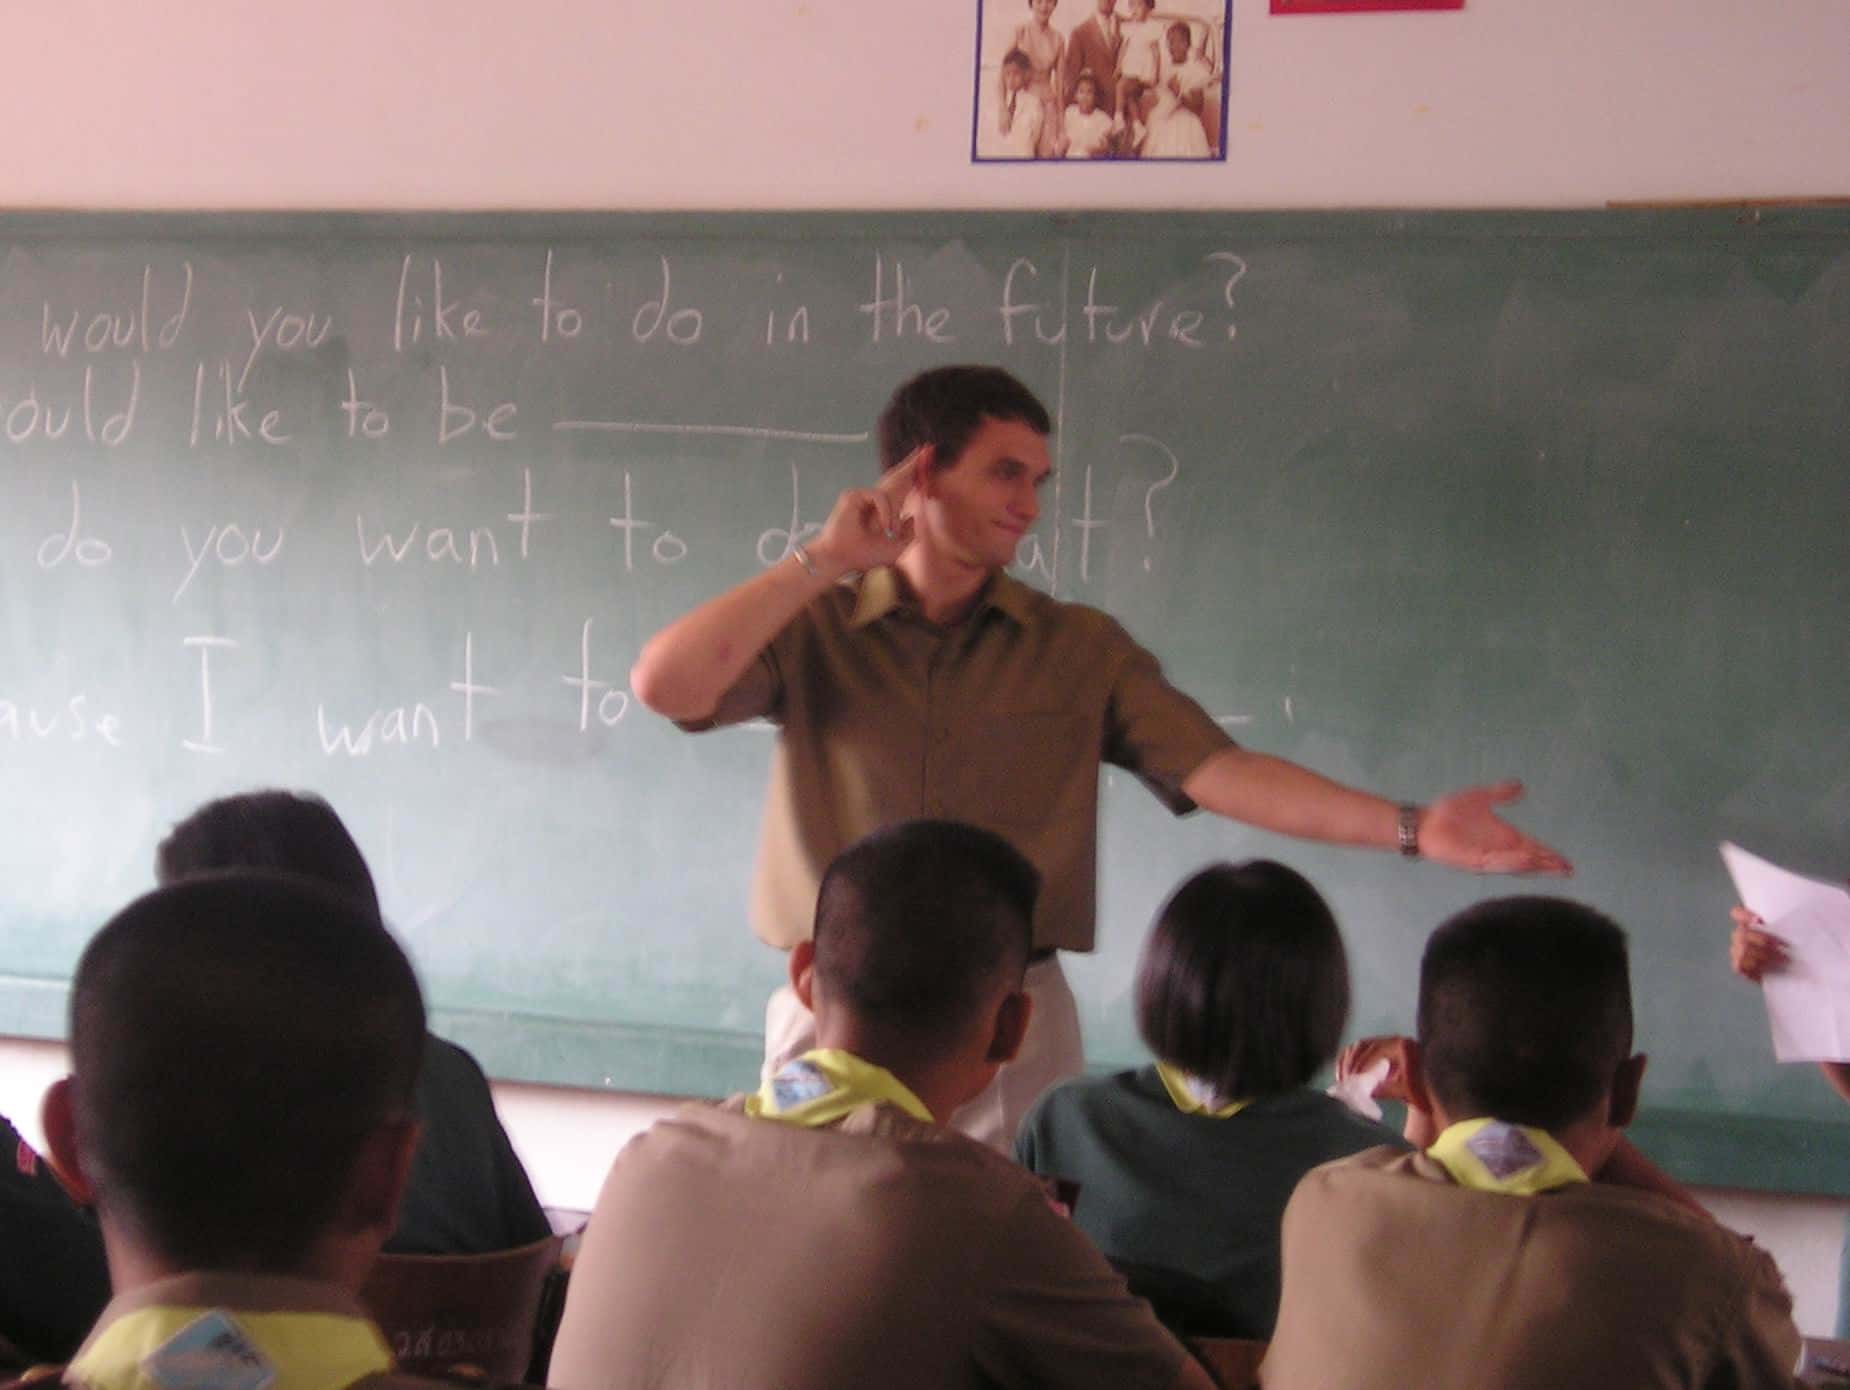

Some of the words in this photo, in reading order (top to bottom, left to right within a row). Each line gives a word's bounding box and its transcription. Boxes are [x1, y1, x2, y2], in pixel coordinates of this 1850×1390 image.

[42, 262, 194, 357] would
[248, 306, 334, 393] you
[395, 254, 487, 351] like
[533, 248, 583, 342] to
[632, 254, 703, 346] do
[766, 272, 810, 346] in
[860, 248, 958, 344] the
[1000, 251, 1247, 348] future?
[4, 361, 141, 446] ould
[190, 361, 292, 446] like
[341, 367, 391, 443] to
[438, 365, 518, 445] be
[36, 480, 113, 568] do
[173, 523, 286, 604] you
[356, 468, 557, 568] want
[609, 470, 688, 571] to
[0, 689, 121, 748] ause
[181, 635, 241, 754] I
[317, 631, 501, 757] want
[562, 617, 631, 733] to
